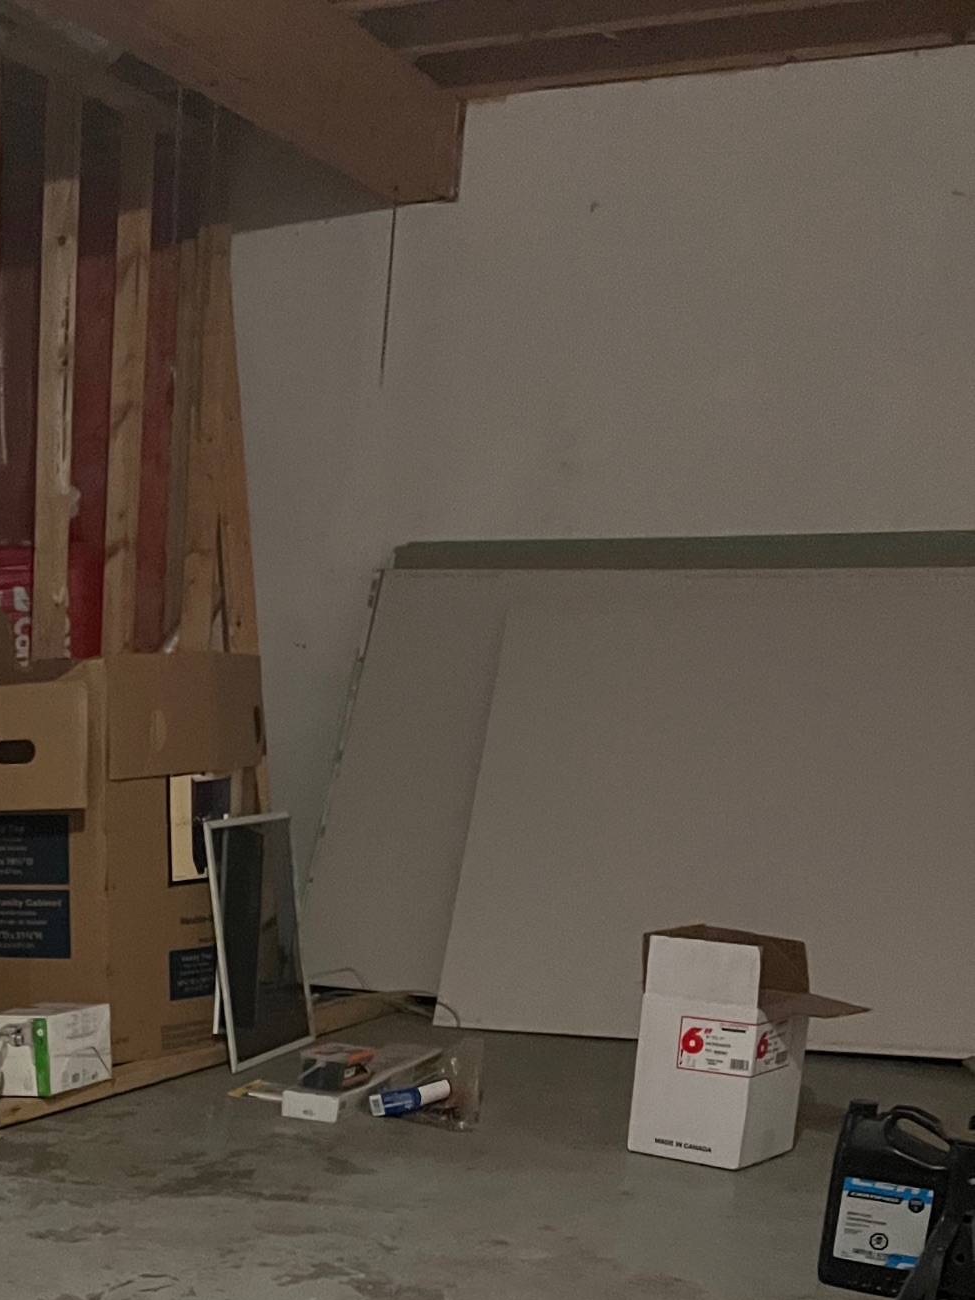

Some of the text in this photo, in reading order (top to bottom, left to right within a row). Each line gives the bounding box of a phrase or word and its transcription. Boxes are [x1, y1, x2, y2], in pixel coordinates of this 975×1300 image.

[654, 1137, 713, 1154] MADE IN CANADA
